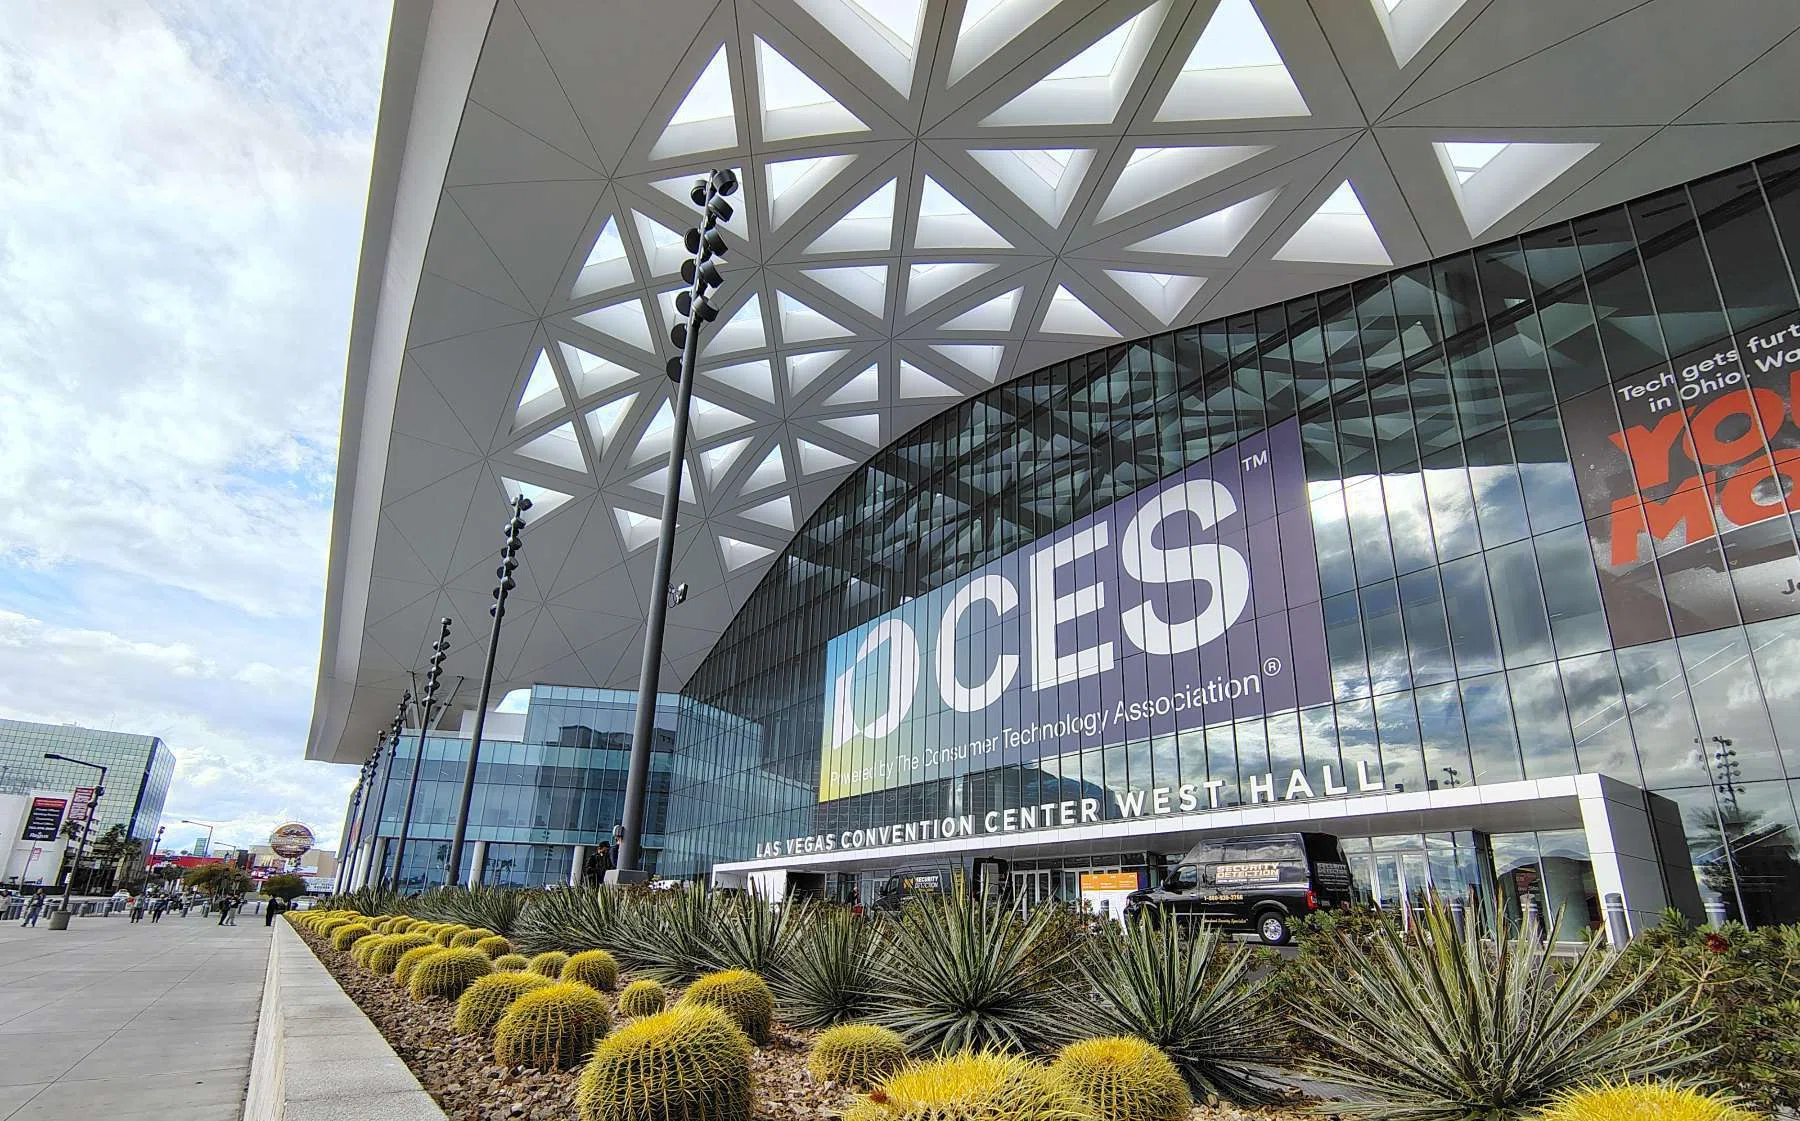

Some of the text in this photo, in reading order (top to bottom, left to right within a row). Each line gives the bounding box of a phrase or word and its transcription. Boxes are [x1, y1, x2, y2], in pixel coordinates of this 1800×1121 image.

[1617, 372, 1675, 401] Tech
[1682, 349, 1739, 382] gets
[1649, 397, 1672, 412] in
[1241, 450, 1268, 472] TM
[830, 765, 877, 785] Powered
[879, 759, 894, 780] by
[895, 754, 919, 771] The
[922, 735, 999, 766] Consumer
[1002, 708, 1109, 750] Technology
[756, 759, 1386, 859] LAS VEGAS CONVENTION CENTER WEST HALL
[1216, 861, 1279, 873] SECURITY
[1216, 869, 1279, 878] DETECTION
